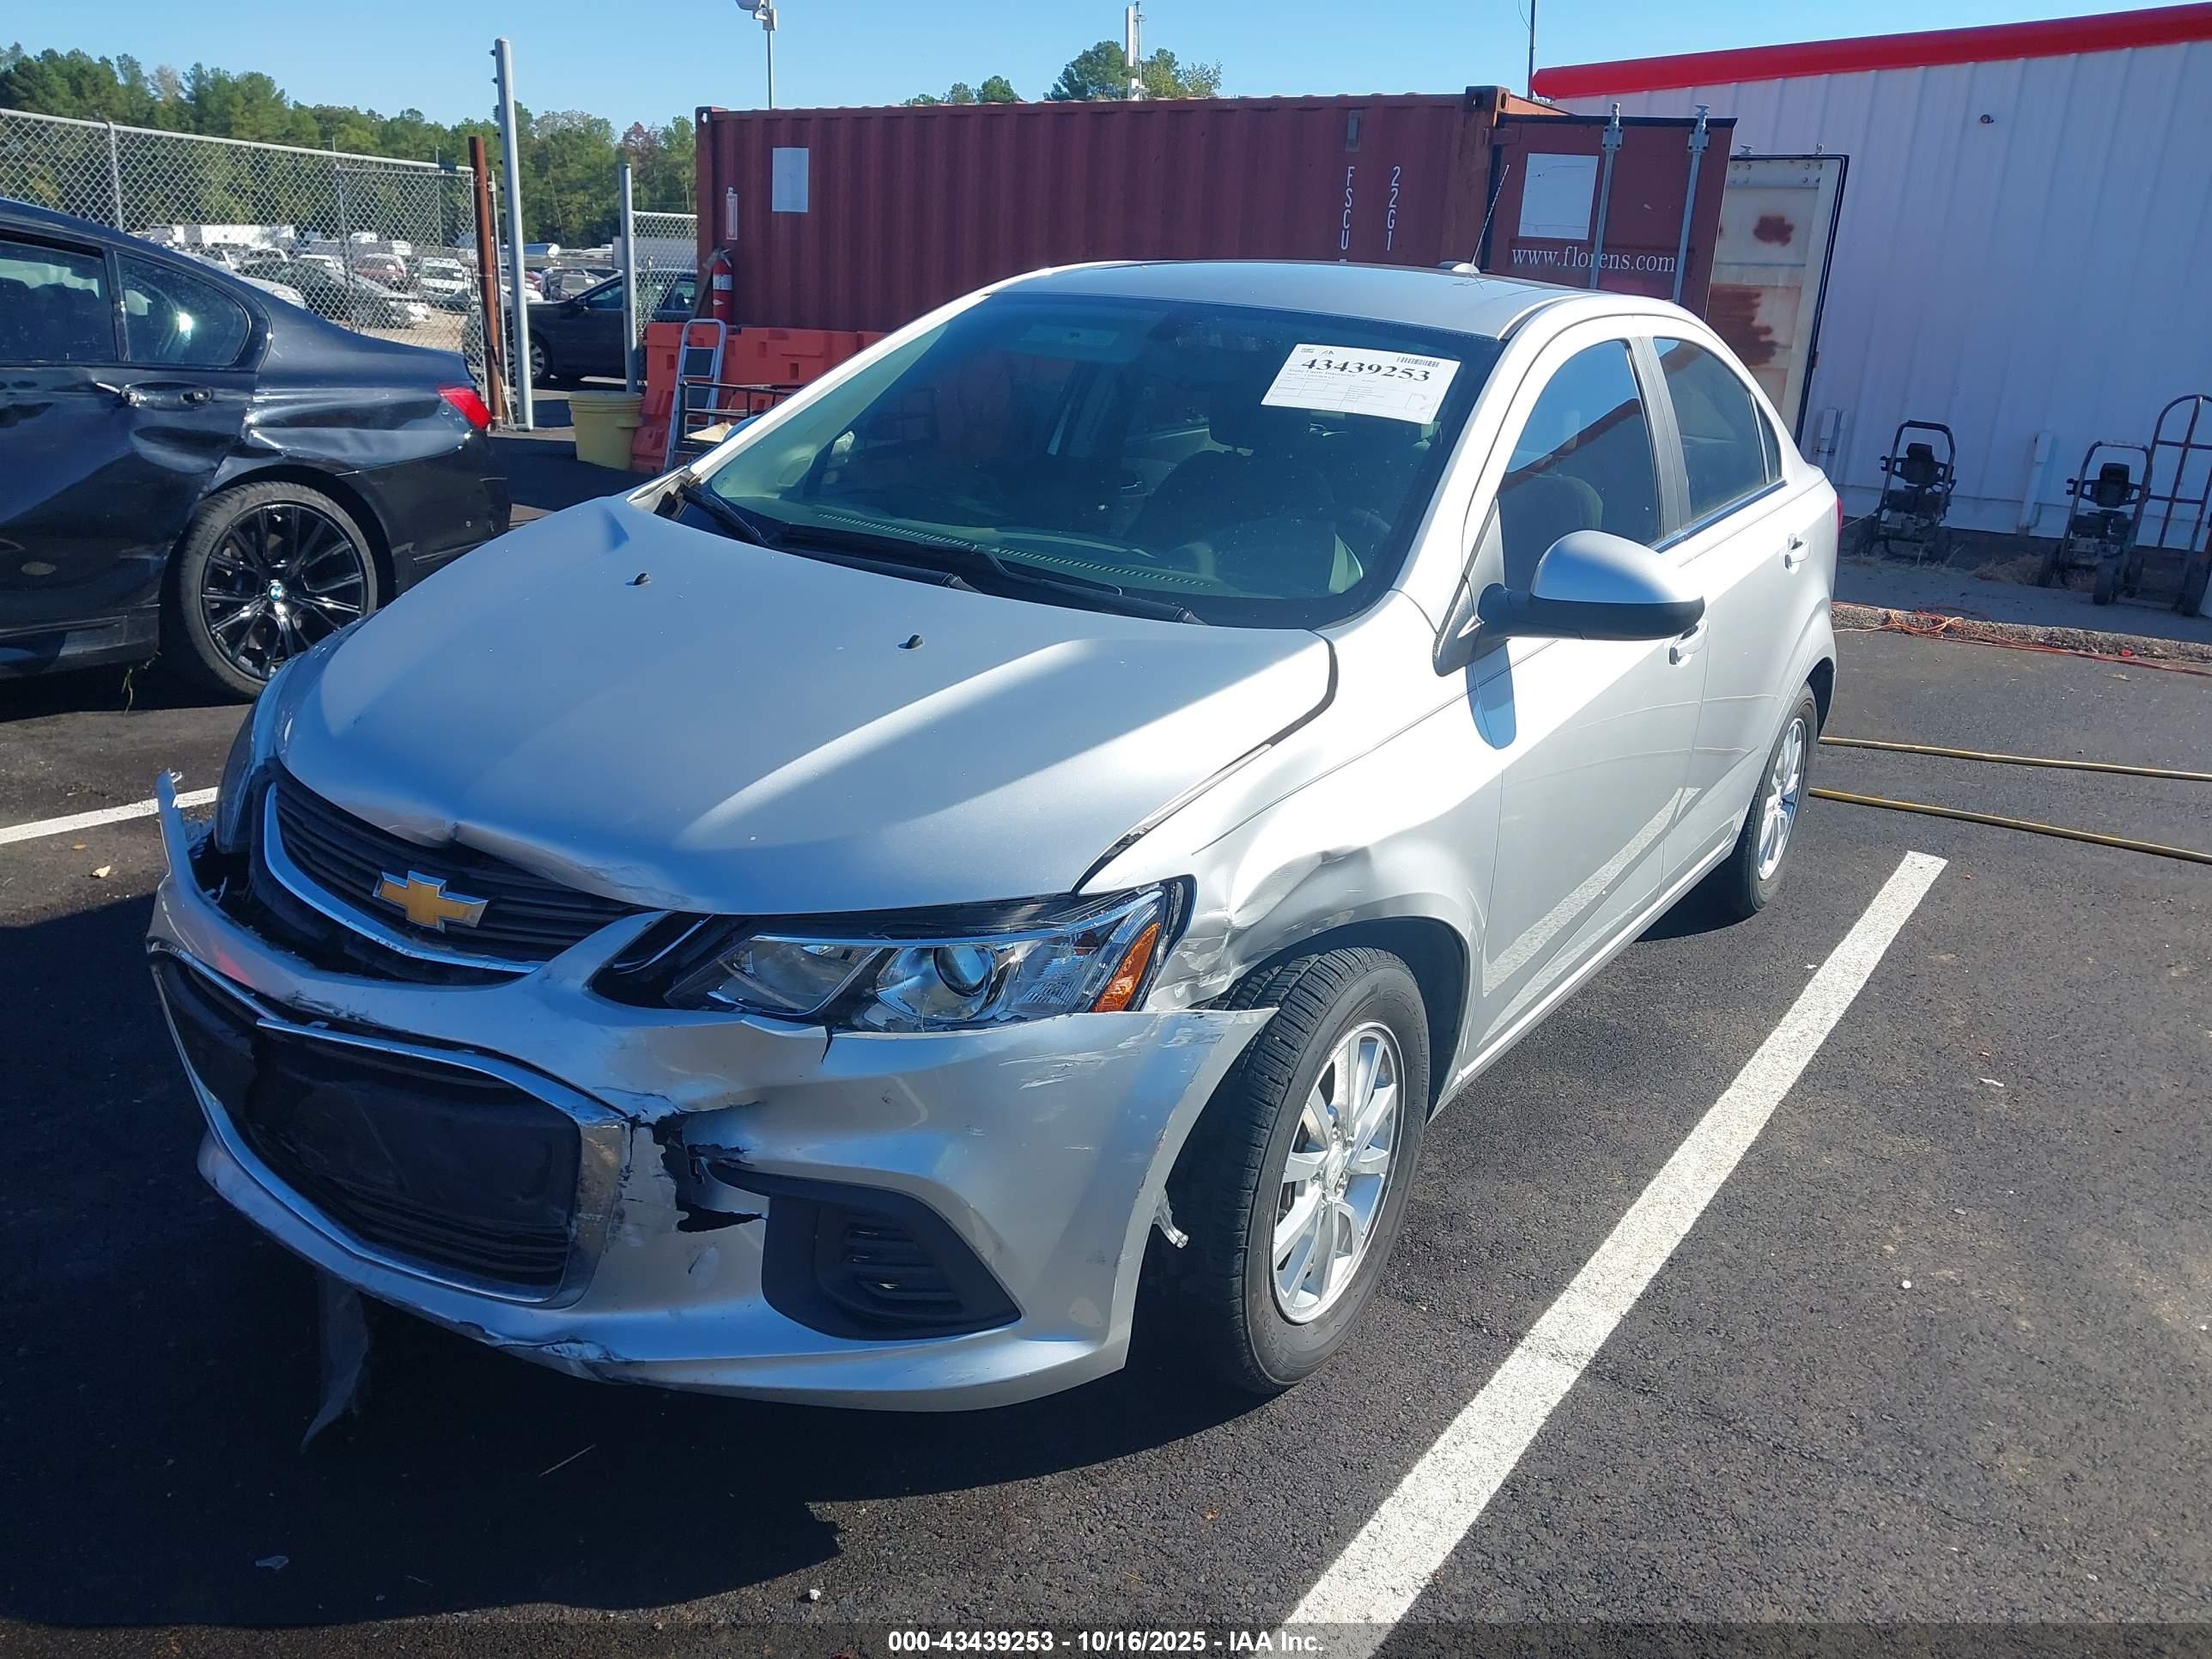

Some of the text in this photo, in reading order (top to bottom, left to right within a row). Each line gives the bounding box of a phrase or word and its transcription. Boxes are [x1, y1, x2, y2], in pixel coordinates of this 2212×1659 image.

[1340, 165, 1356, 251] FSCU
[1386, 165, 1401, 252] 22G1
[1511, 246, 1676, 272] www.florens.com
[1300, 358, 1431, 382] 43439253
